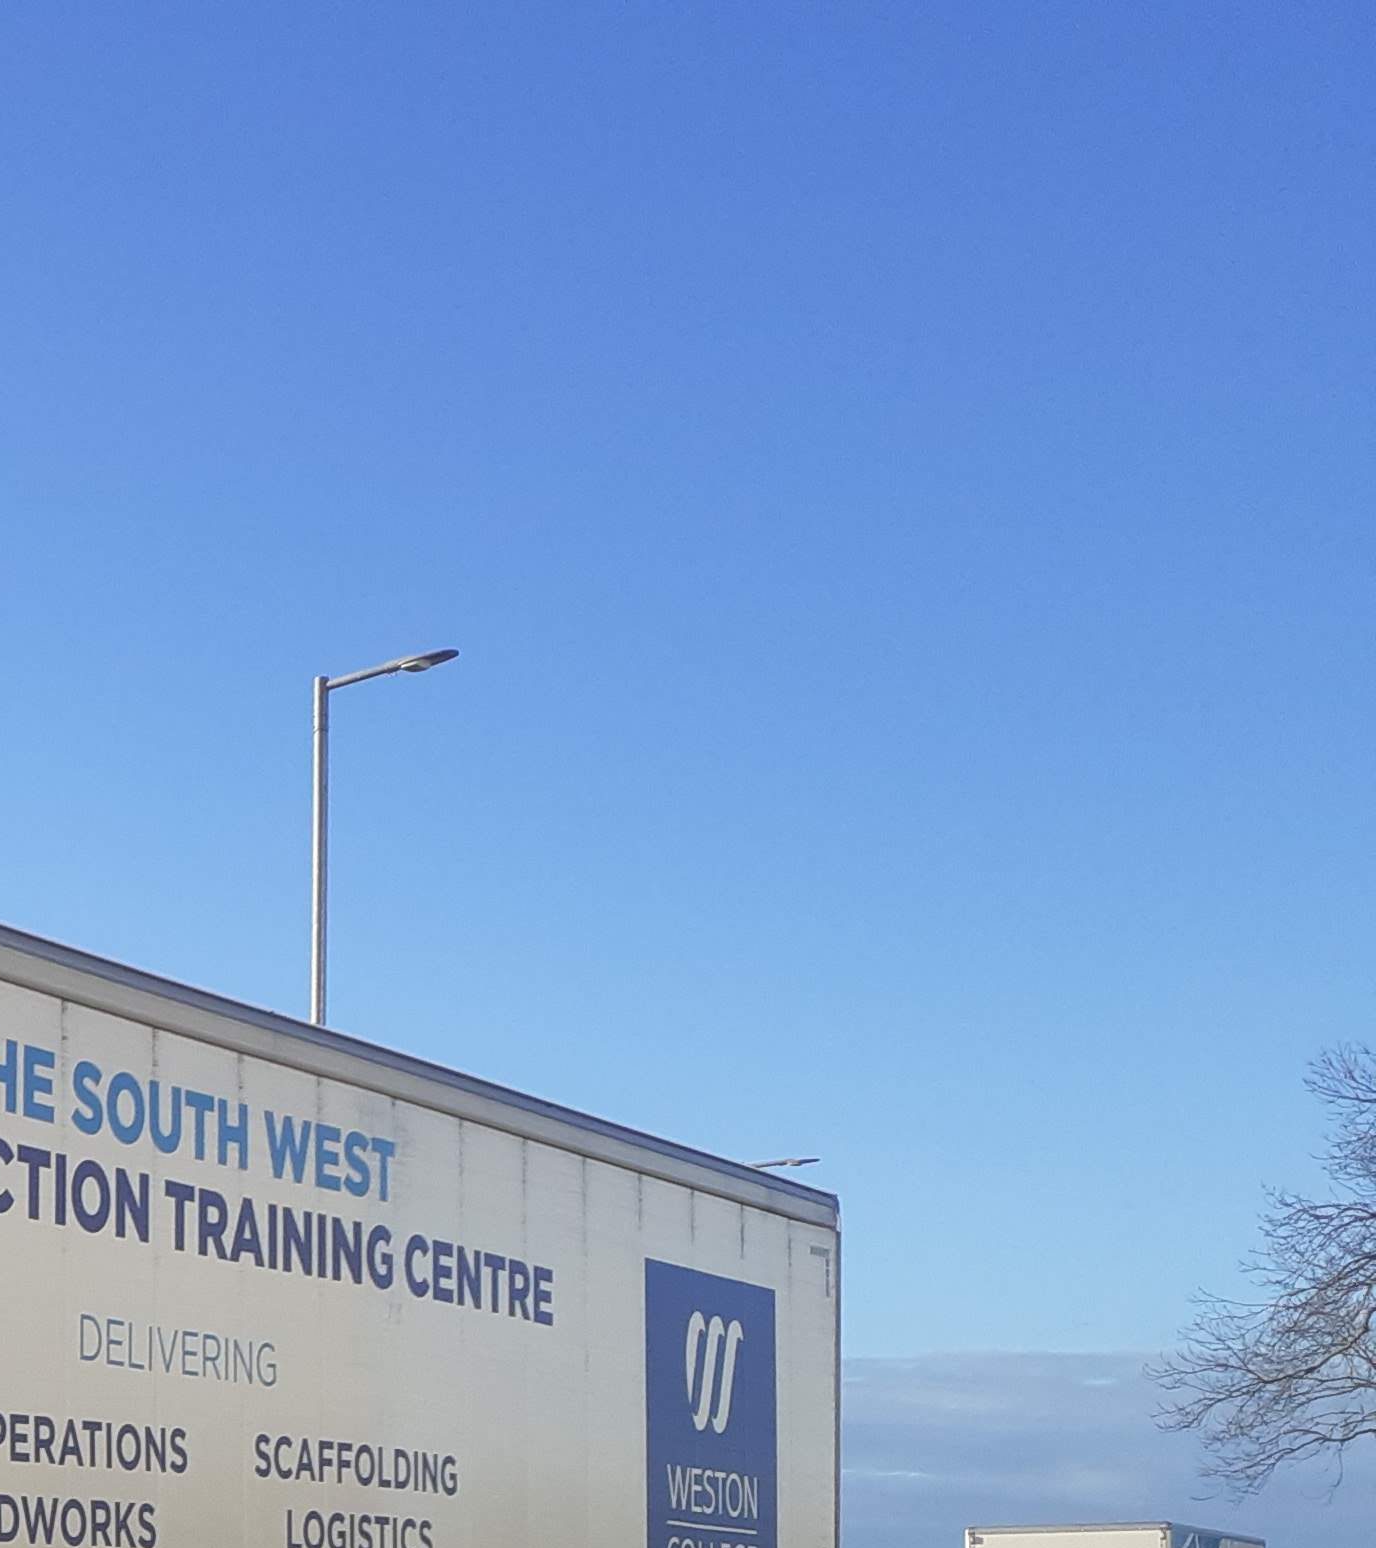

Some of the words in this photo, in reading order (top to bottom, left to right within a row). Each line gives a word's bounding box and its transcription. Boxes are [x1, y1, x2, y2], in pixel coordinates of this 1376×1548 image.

[71, 1060, 248, 1171] SOUTH
[264, 1110, 395, 1201] WEST
[165, 1179, 393, 1290] TRAINING
[405, 1234, 553, 1326] CENTRE
[79, 1313, 277, 1387] DELIVERING
[254, 1433, 459, 1497] SCAFFOLDING
[666, 1463, 758, 1520] WESTON
